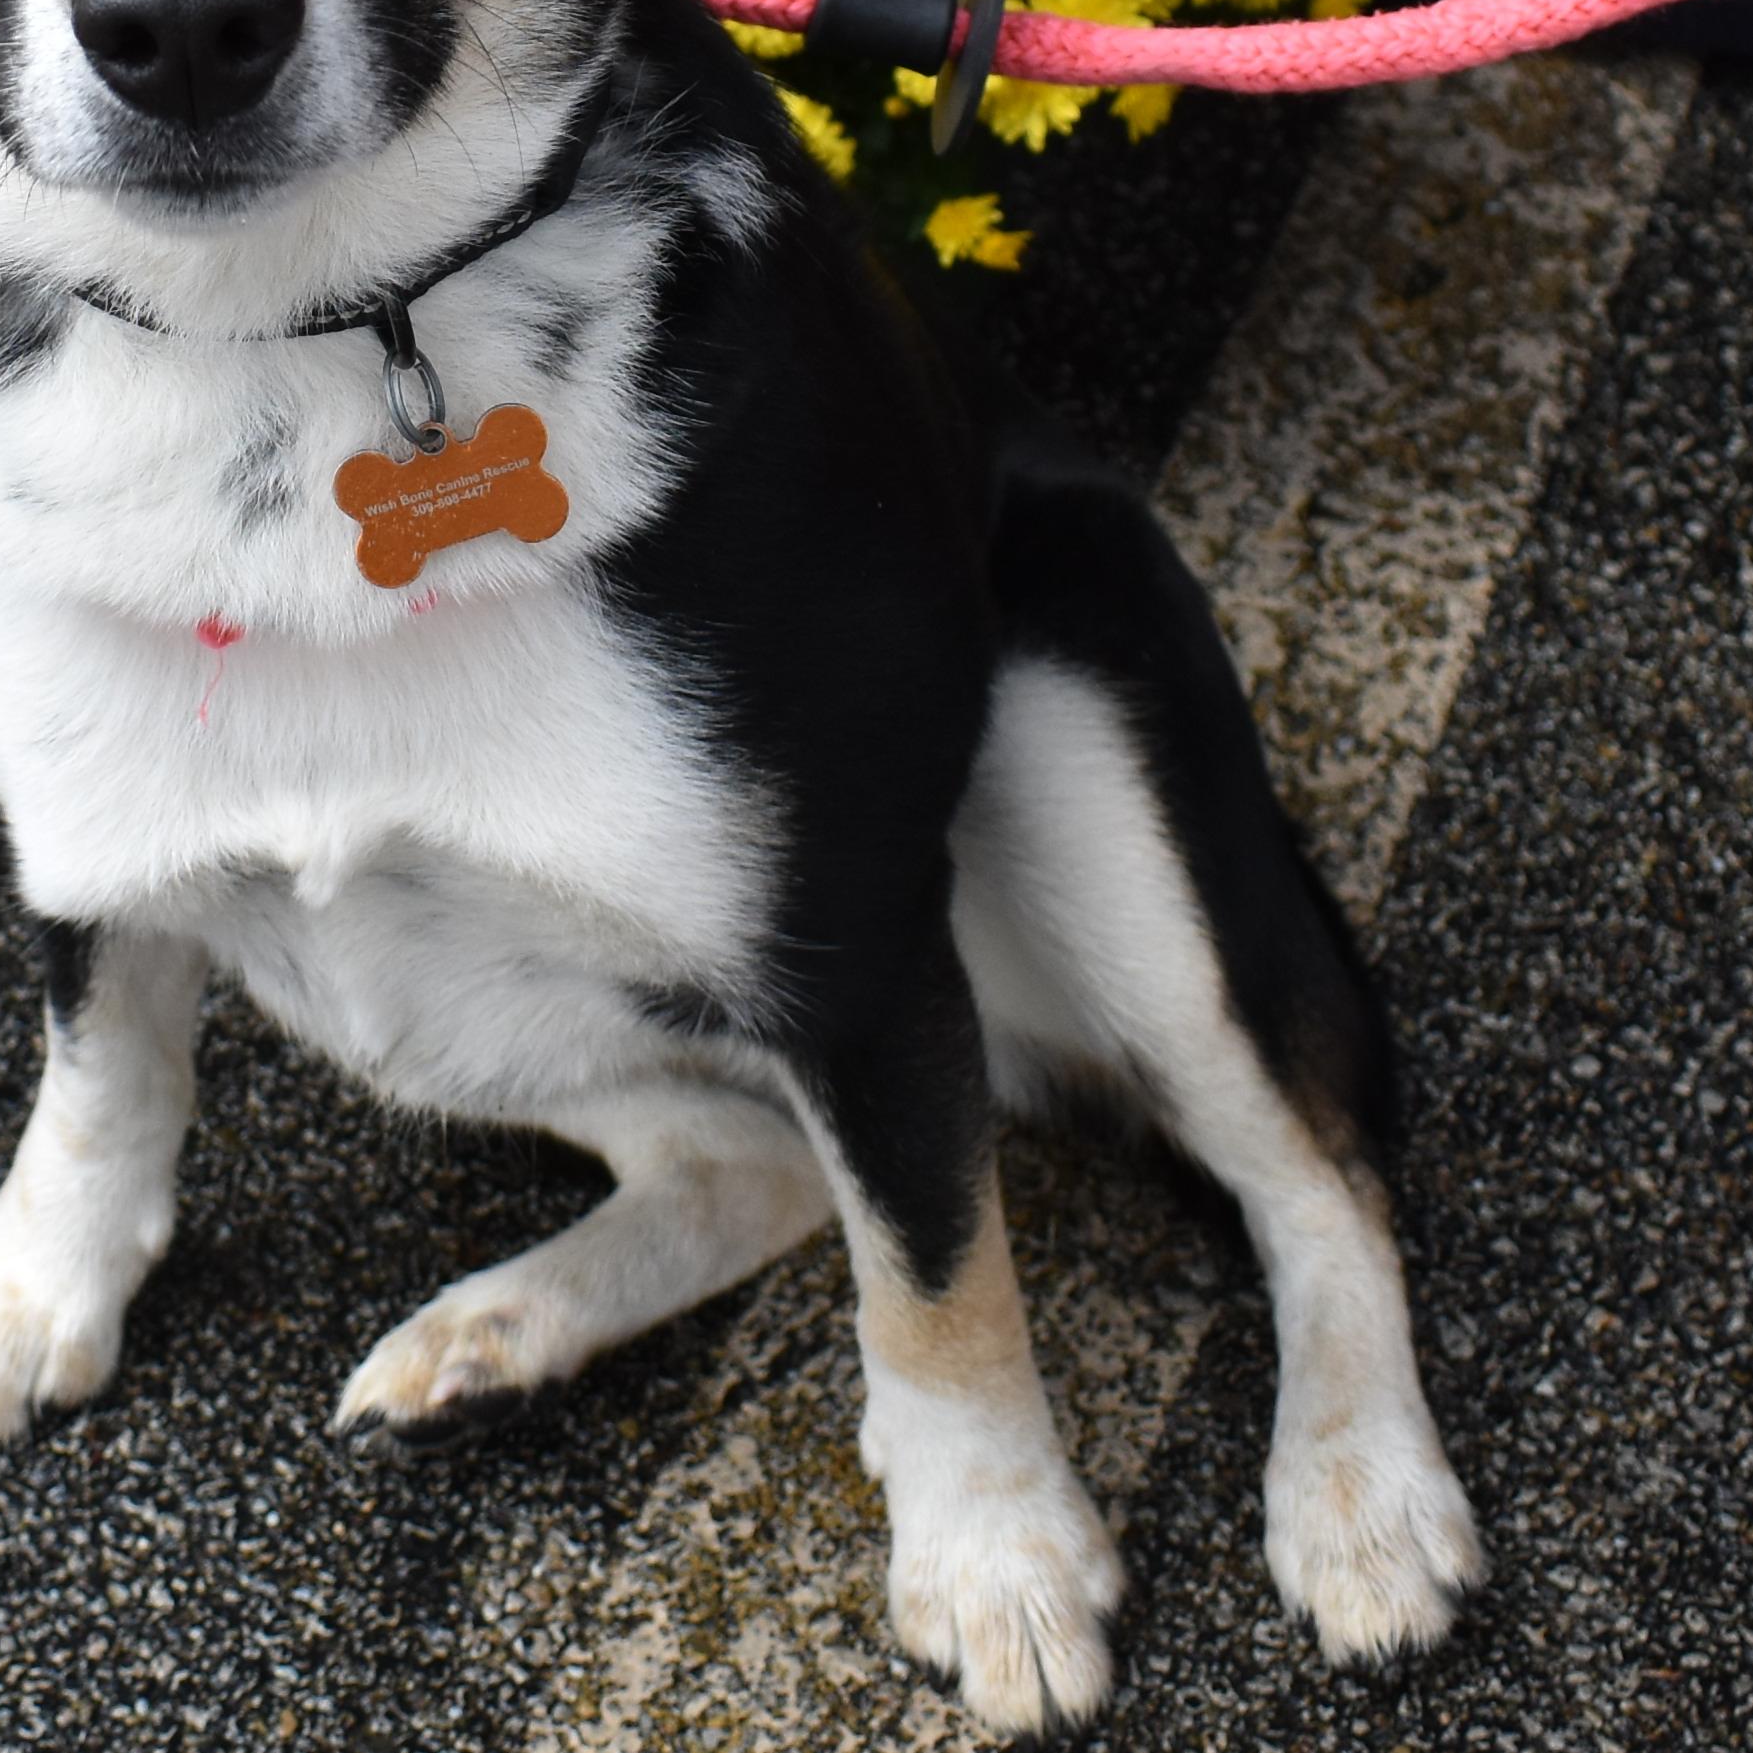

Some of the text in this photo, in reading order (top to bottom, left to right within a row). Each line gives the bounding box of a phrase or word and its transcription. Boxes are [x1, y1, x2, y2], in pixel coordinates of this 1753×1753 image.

[364, 457, 530, 517] Wish Bone Canine Rescue
